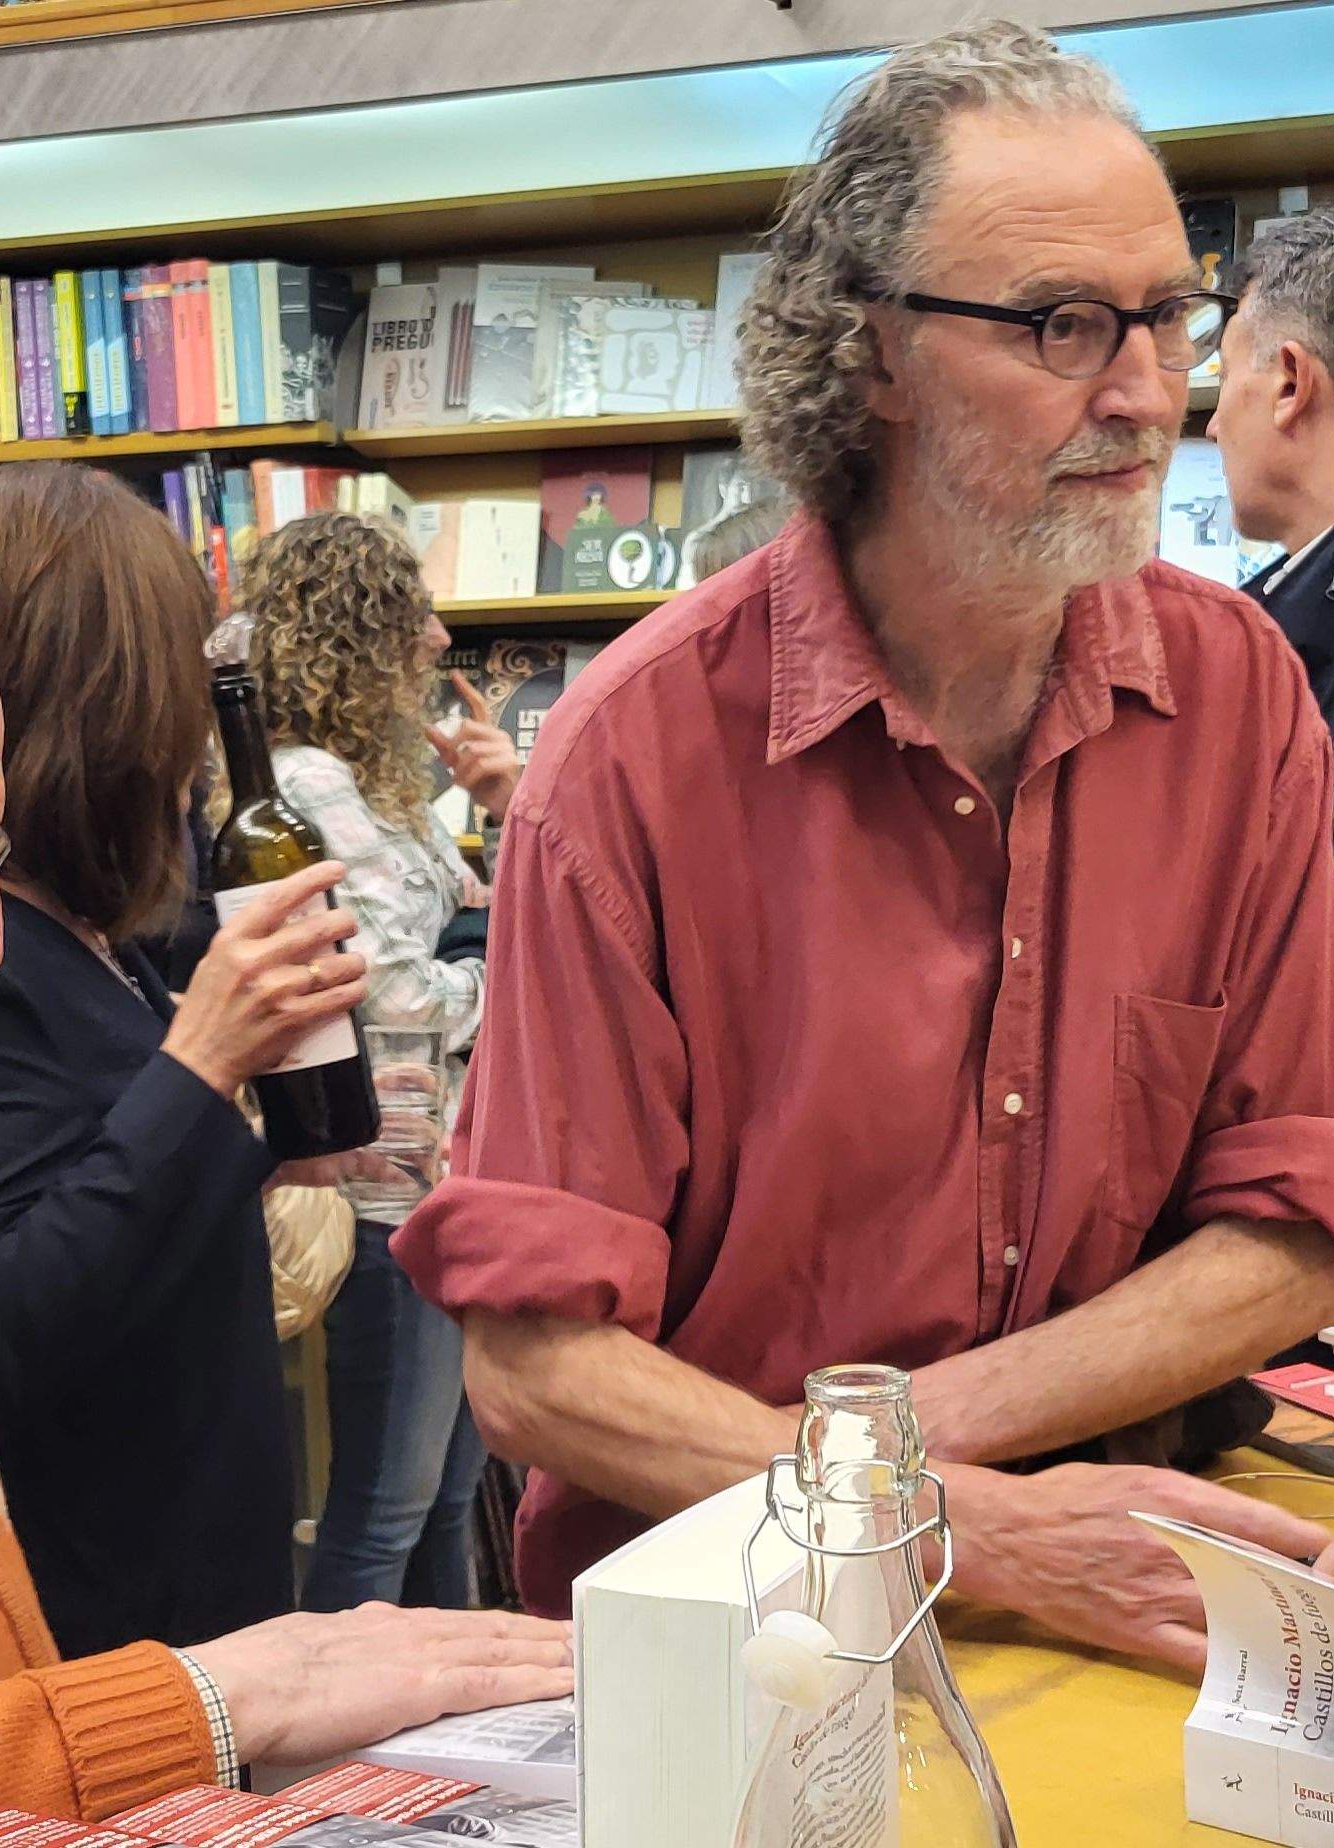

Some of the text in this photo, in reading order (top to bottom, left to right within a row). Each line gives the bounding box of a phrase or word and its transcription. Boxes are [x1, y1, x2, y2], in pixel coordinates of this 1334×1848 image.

[371, 333, 435, 354] PREGU
[1310, 1621, 1331, 1645] de
[1270, 1652, 1303, 1736] Ignacio
[1302, 1649, 1334, 1742] Castillos
